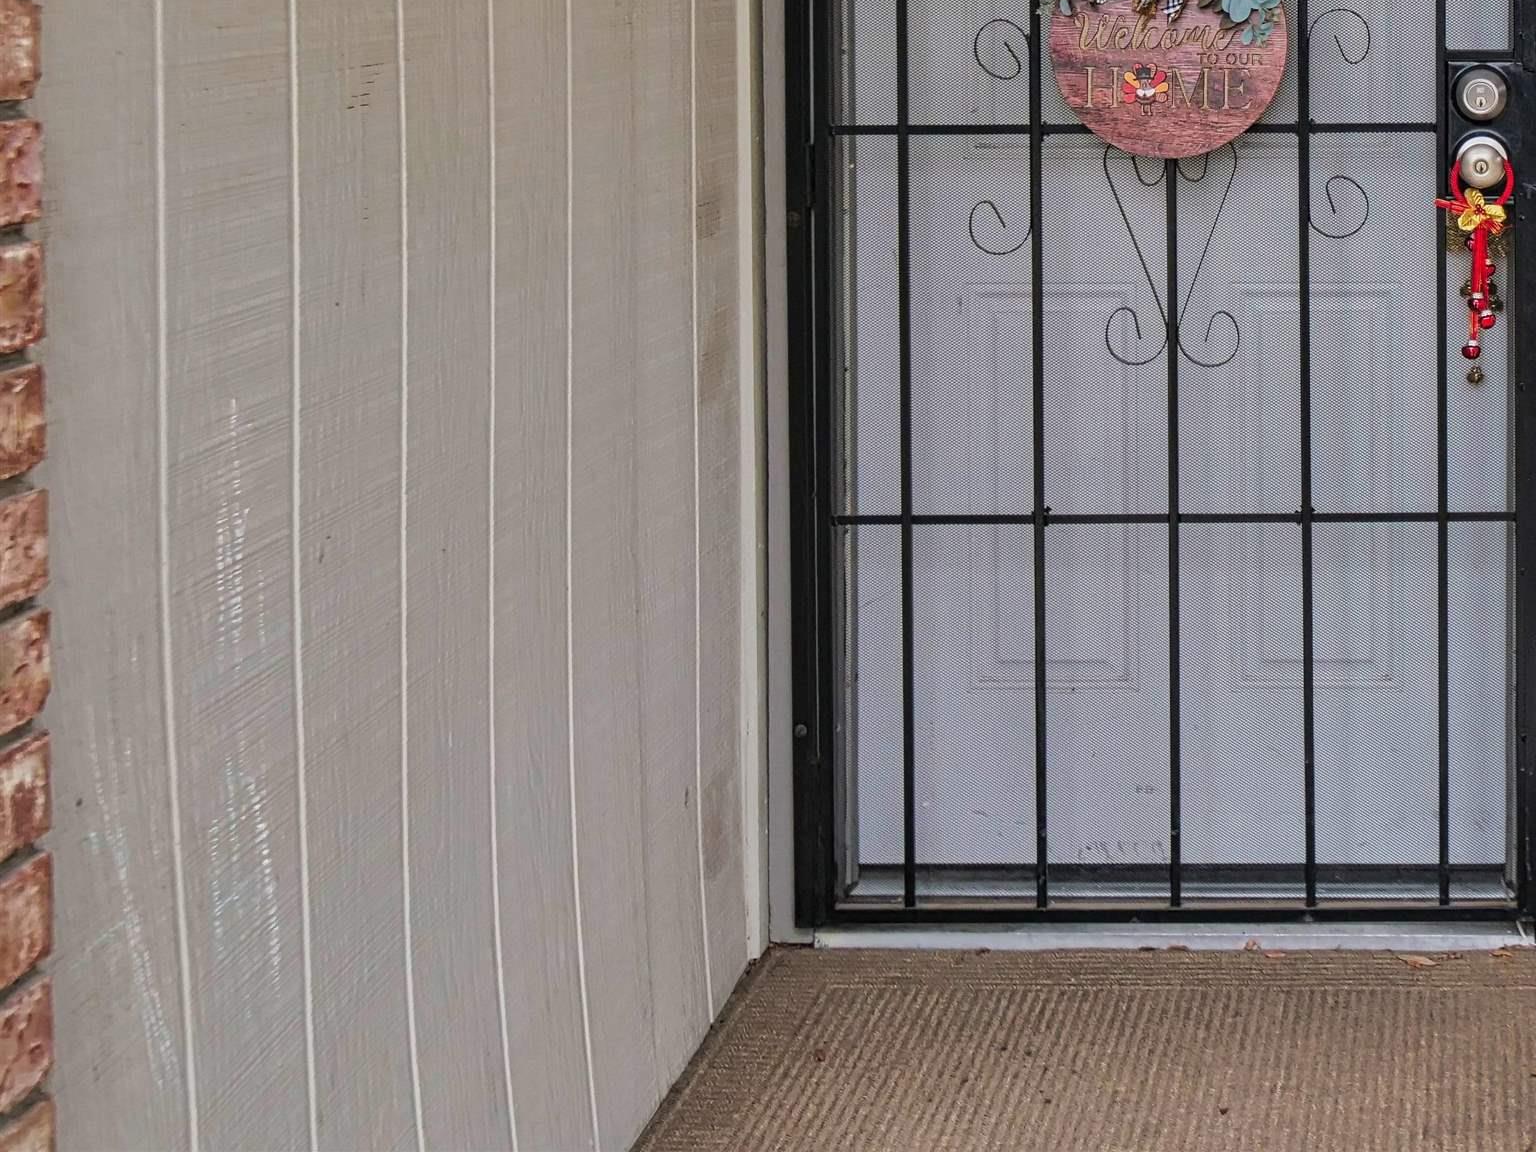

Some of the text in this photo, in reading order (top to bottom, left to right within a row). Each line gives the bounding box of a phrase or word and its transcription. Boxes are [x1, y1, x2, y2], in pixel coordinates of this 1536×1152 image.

[1074, 11, 1238, 51] Welcome
[1196, 52, 1263, 66] TO OUR
[1083, 65, 1252, 110] HME
